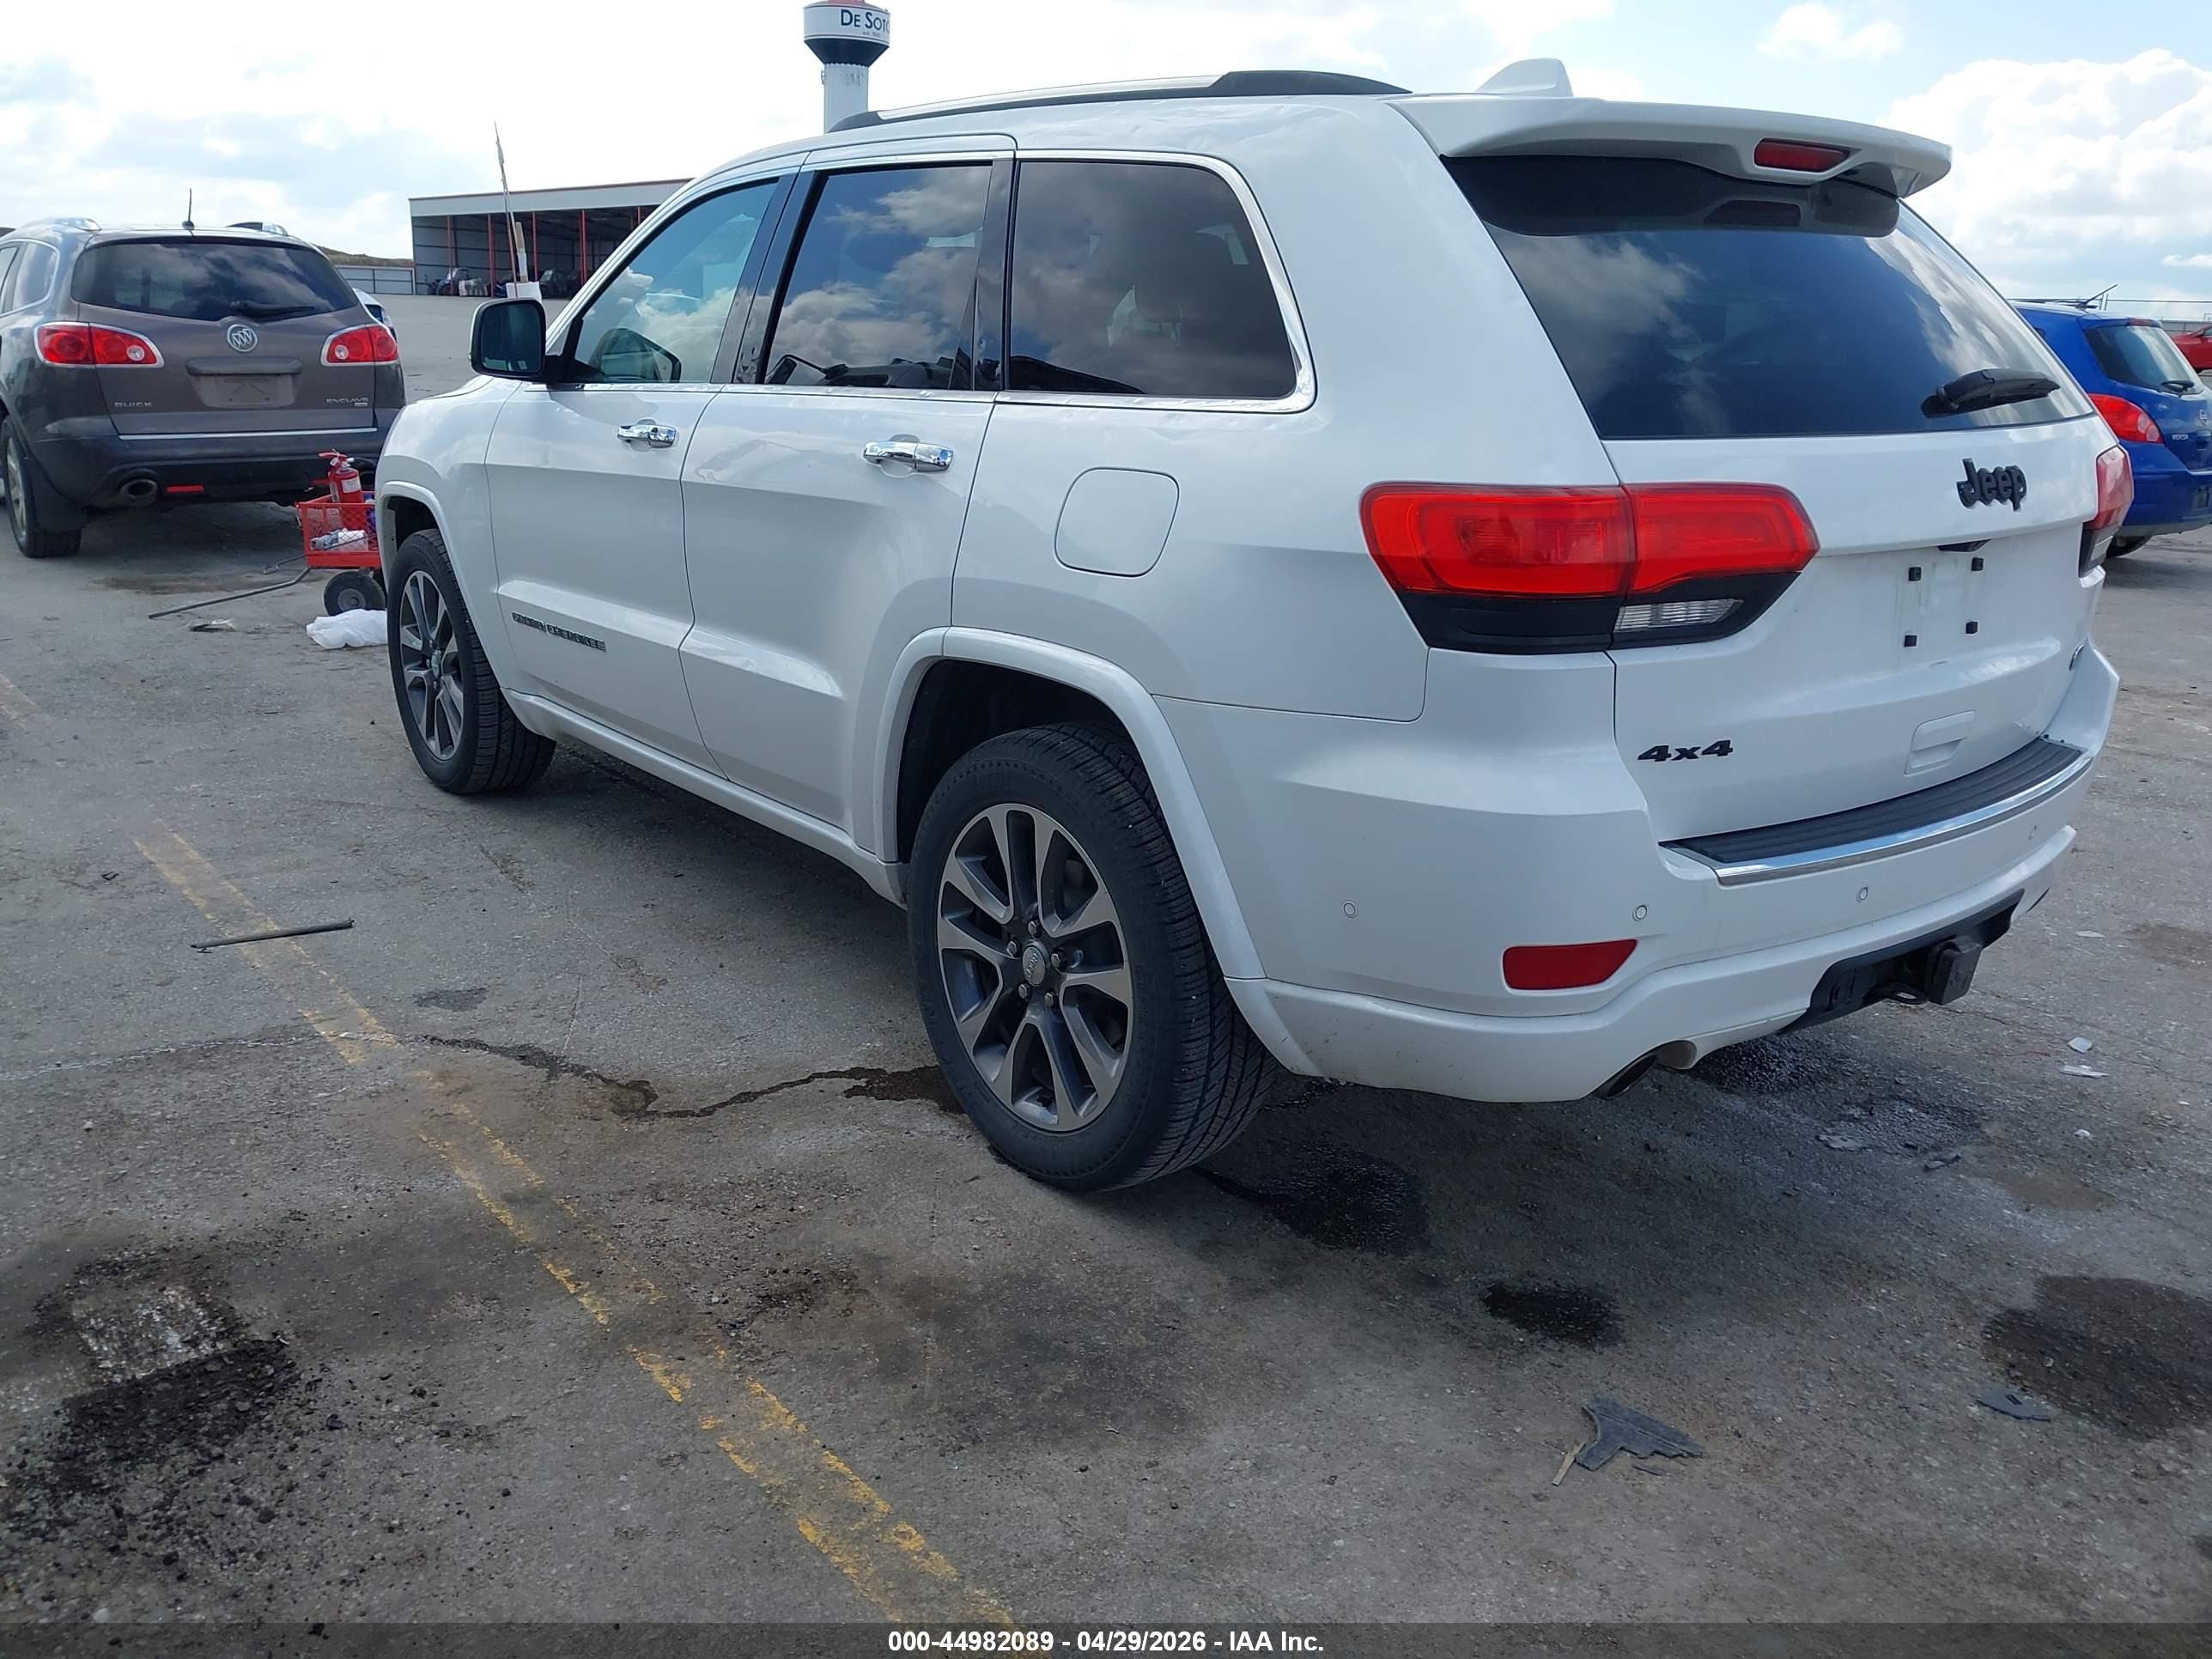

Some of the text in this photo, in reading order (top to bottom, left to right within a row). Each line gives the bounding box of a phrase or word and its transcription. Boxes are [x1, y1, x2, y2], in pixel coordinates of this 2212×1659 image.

[841, 9, 861, 27] DE
[1956, 458, 2027, 512] Jeep
[1637, 739, 1734, 763] 4x4
